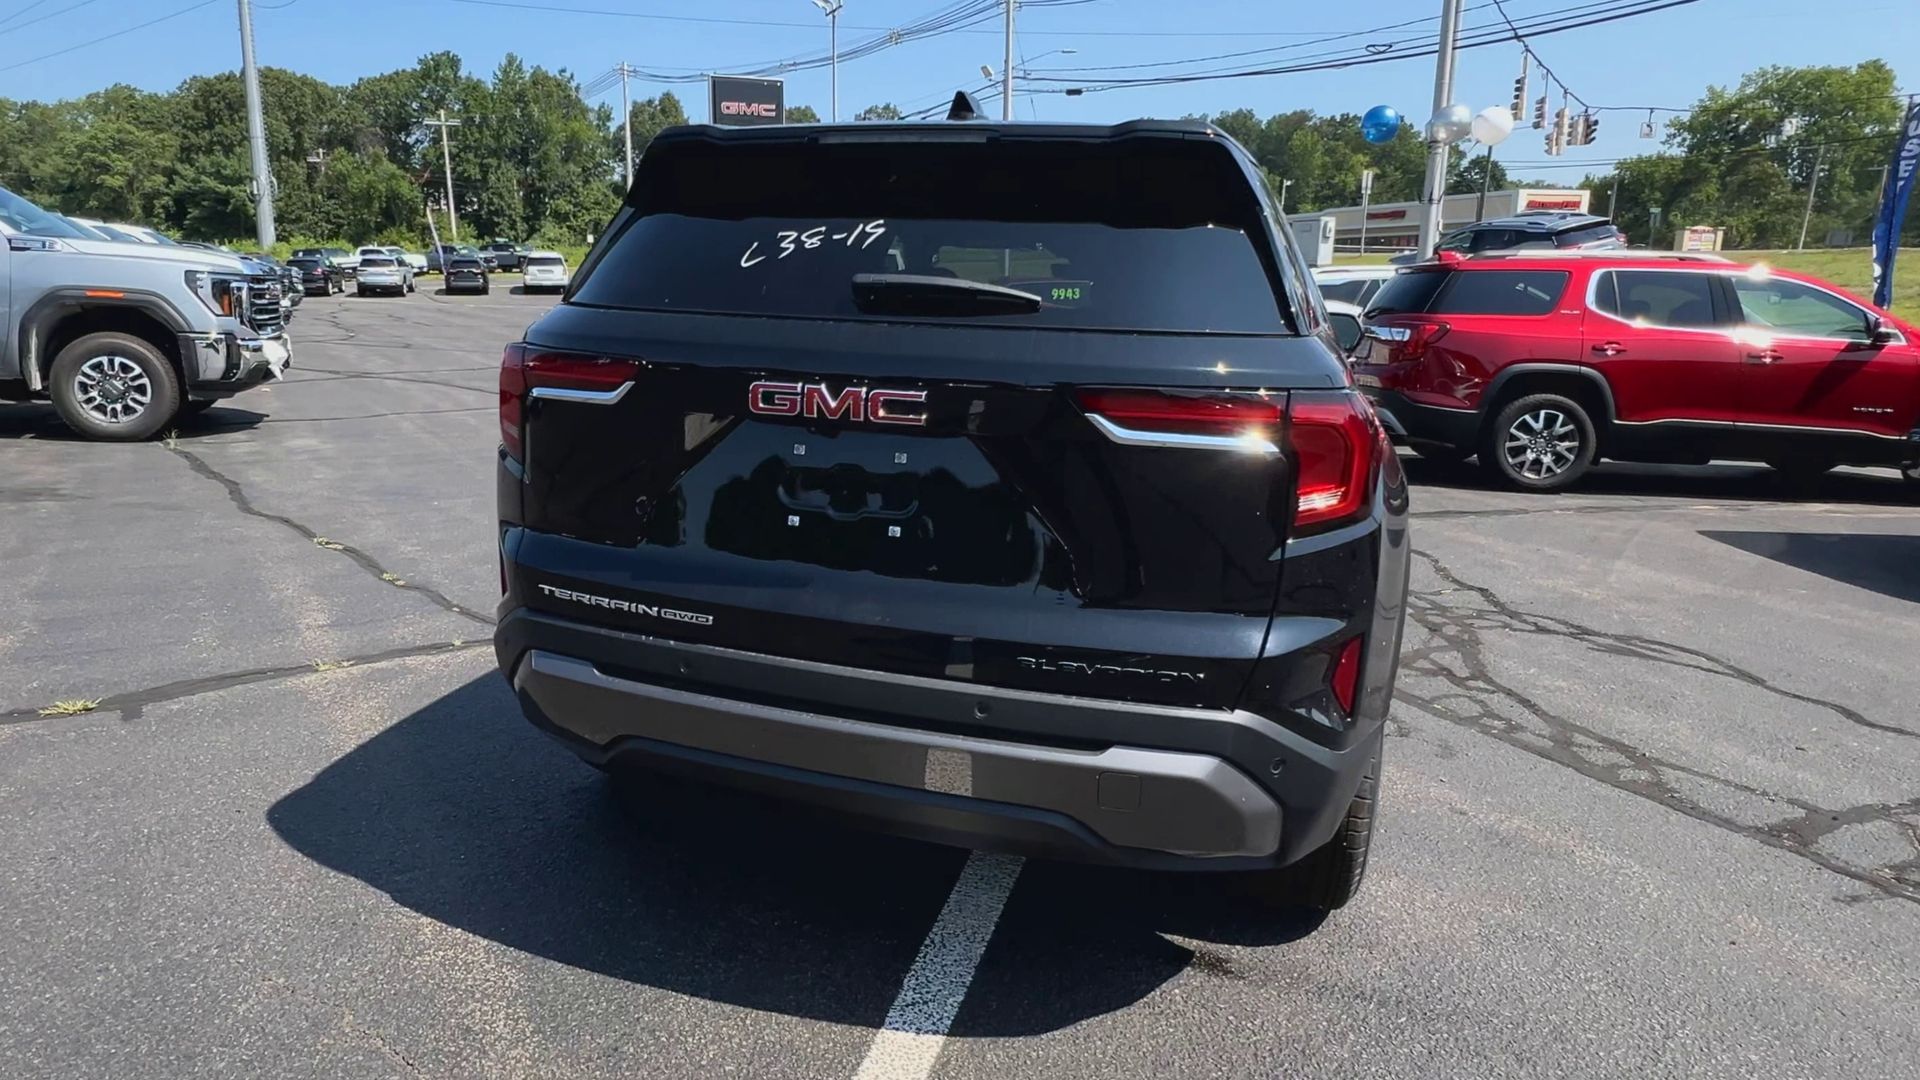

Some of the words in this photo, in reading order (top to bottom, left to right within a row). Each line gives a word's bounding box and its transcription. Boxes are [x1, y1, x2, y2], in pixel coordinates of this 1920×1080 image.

[721, 101, 776, 117] GMC
[1896, 119, 1920, 192] USE
[1051, 288, 1080, 300] 9943
[749, 382, 928, 426] GMC
[538, 584, 658, 617] TERRAIN
[661, 608, 714, 625] AWD
